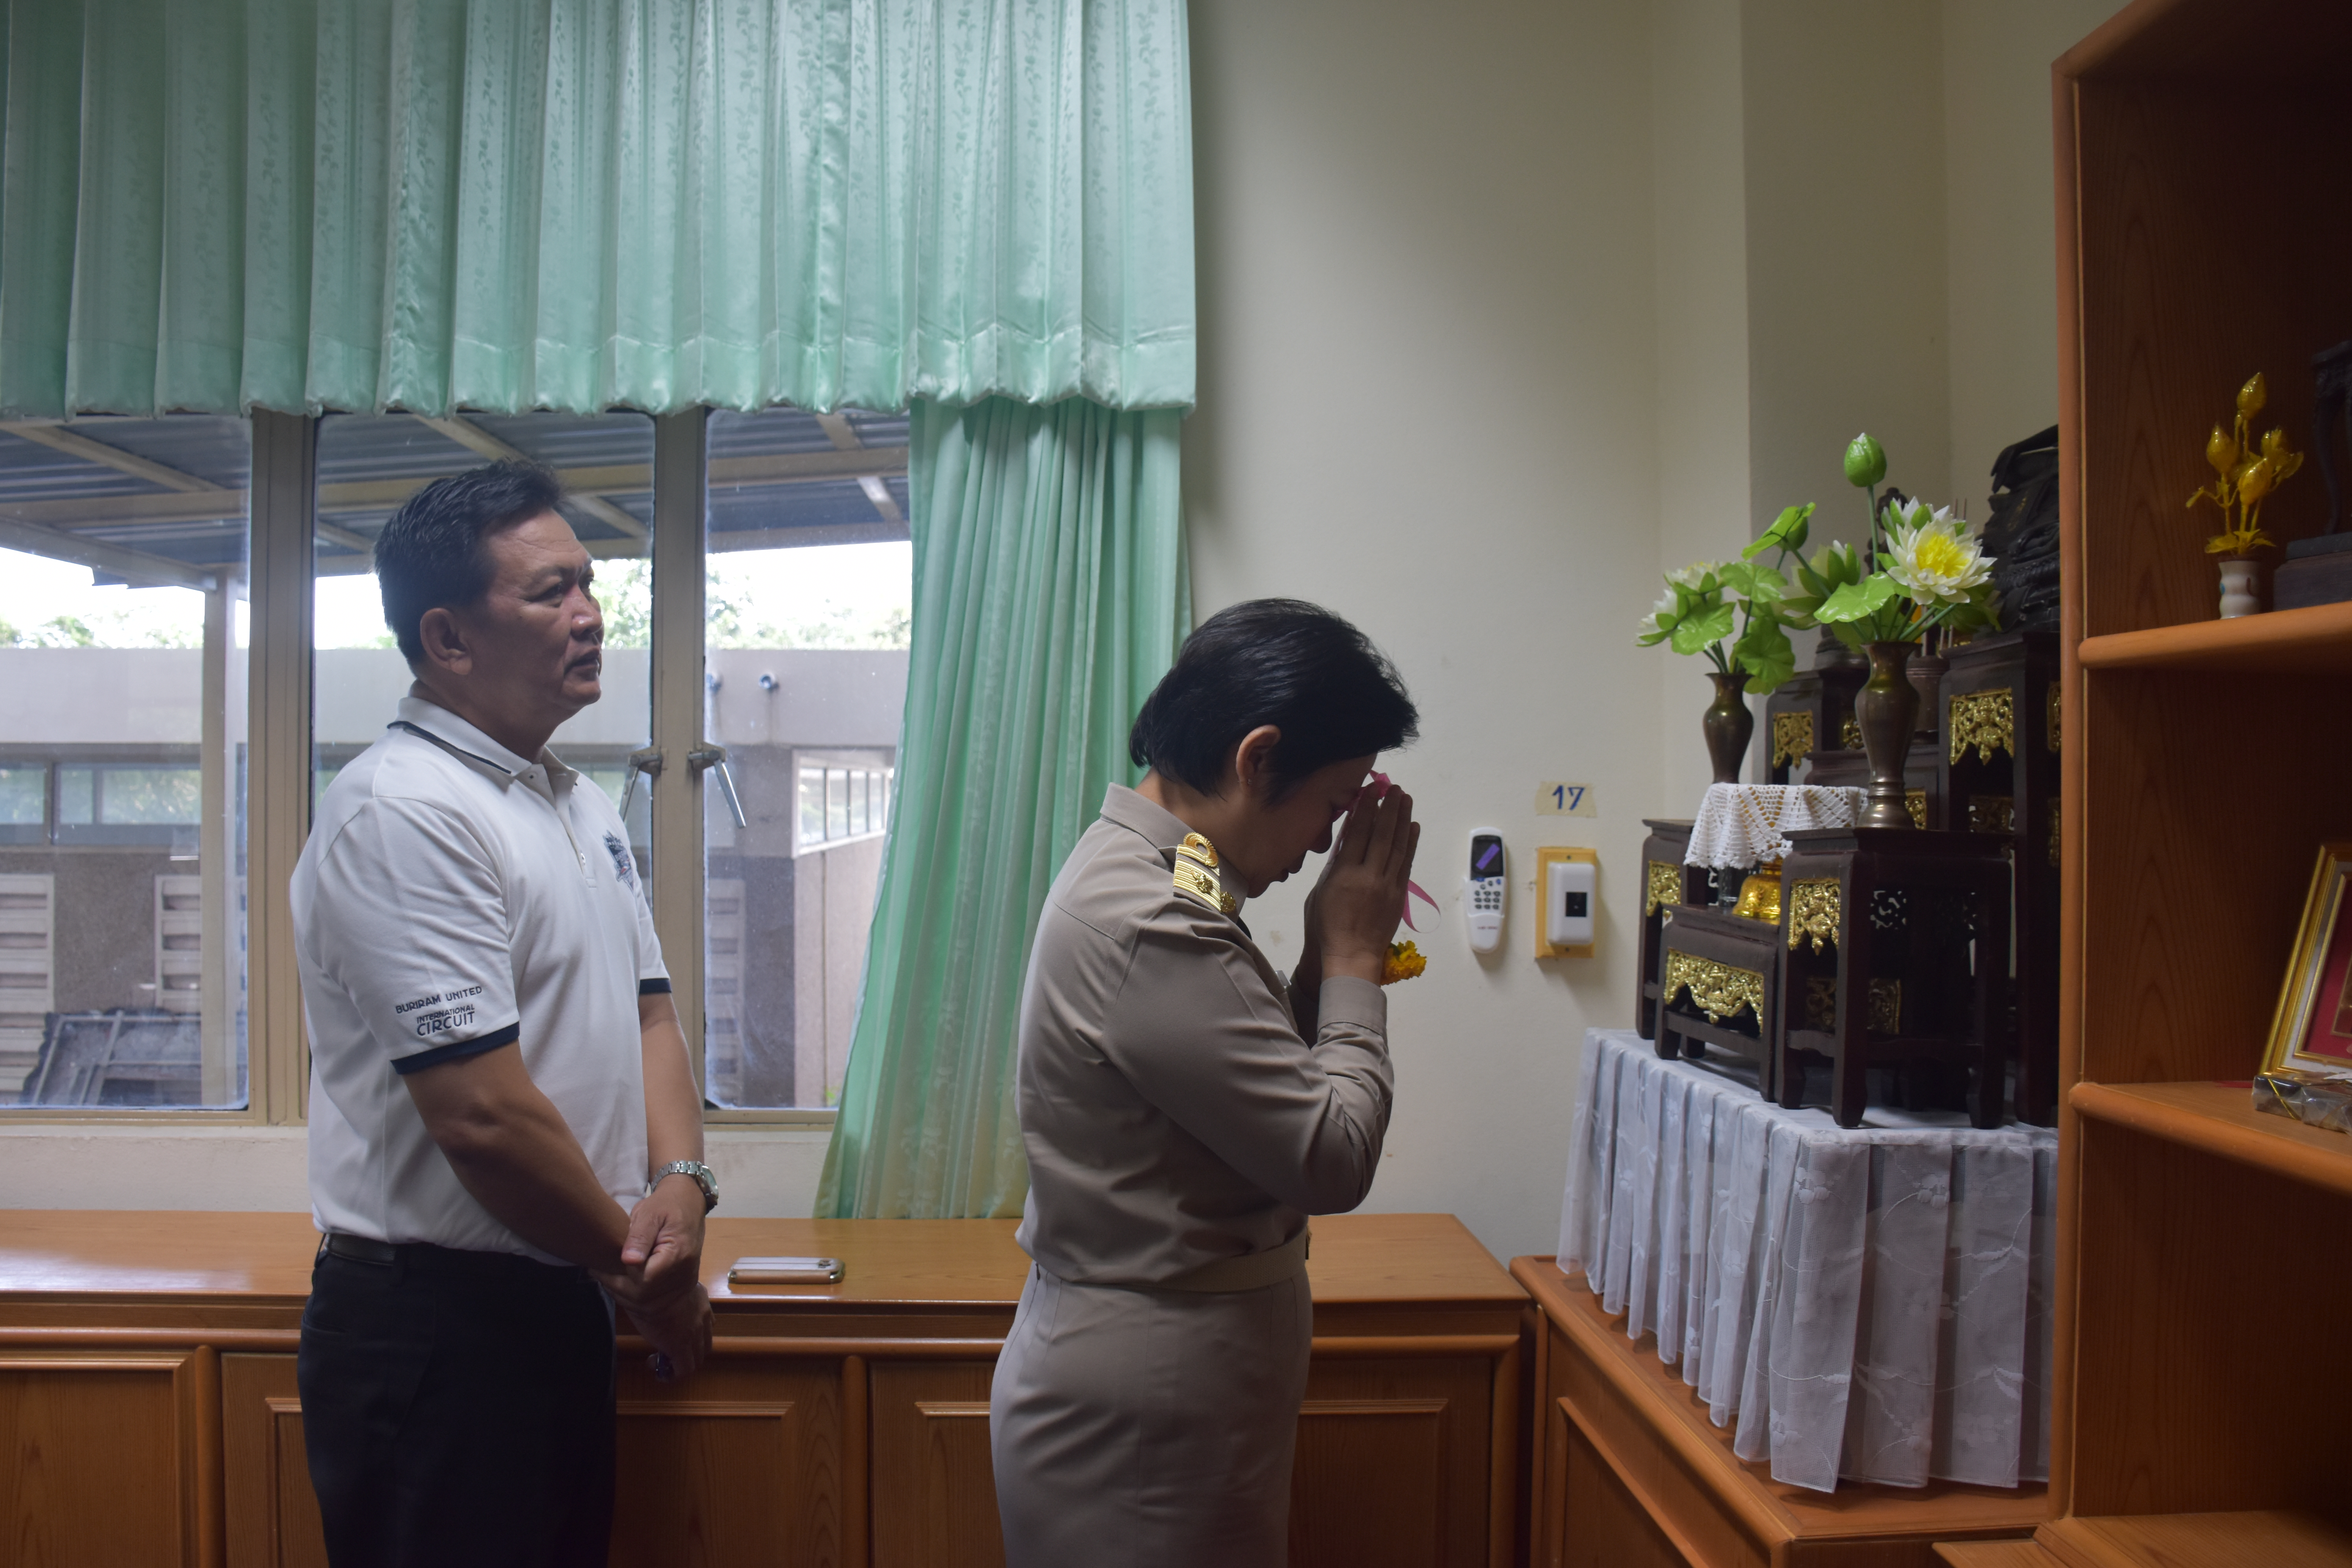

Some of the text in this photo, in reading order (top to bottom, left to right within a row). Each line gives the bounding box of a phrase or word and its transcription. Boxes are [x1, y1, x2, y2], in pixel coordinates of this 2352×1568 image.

[1552, 785, 1585, 810] 17
[396, 986, 482, 1014] BURIRAM UNITED
[417, 1004, 475, 1024] INTERNATIONAL
[417, 1011, 475, 1036] CIRCUIT
